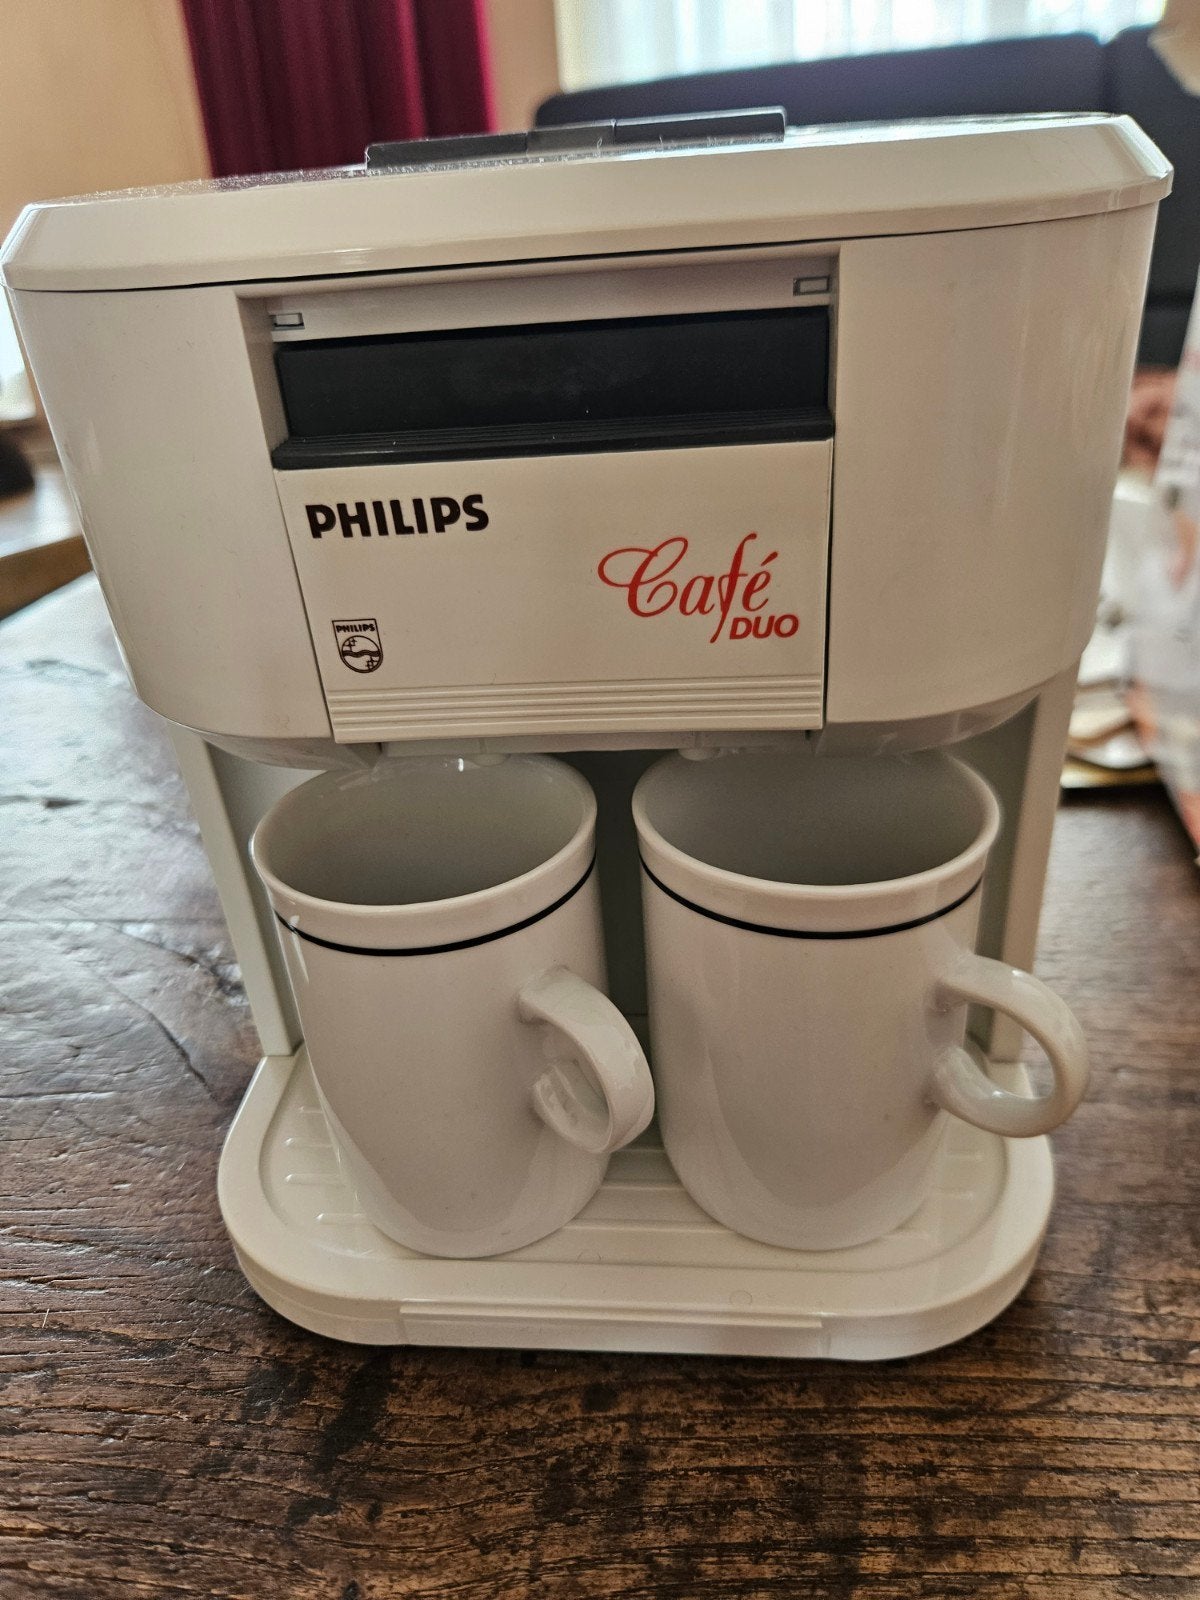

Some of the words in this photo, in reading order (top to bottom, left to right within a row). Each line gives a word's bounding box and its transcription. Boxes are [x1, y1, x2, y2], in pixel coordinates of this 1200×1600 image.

[304, 494, 490, 539] PHILIPS
[597, 532, 779, 643] Café
[335, 623, 376, 633] PHILIPS
[729, 613, 800, 641] DUO
